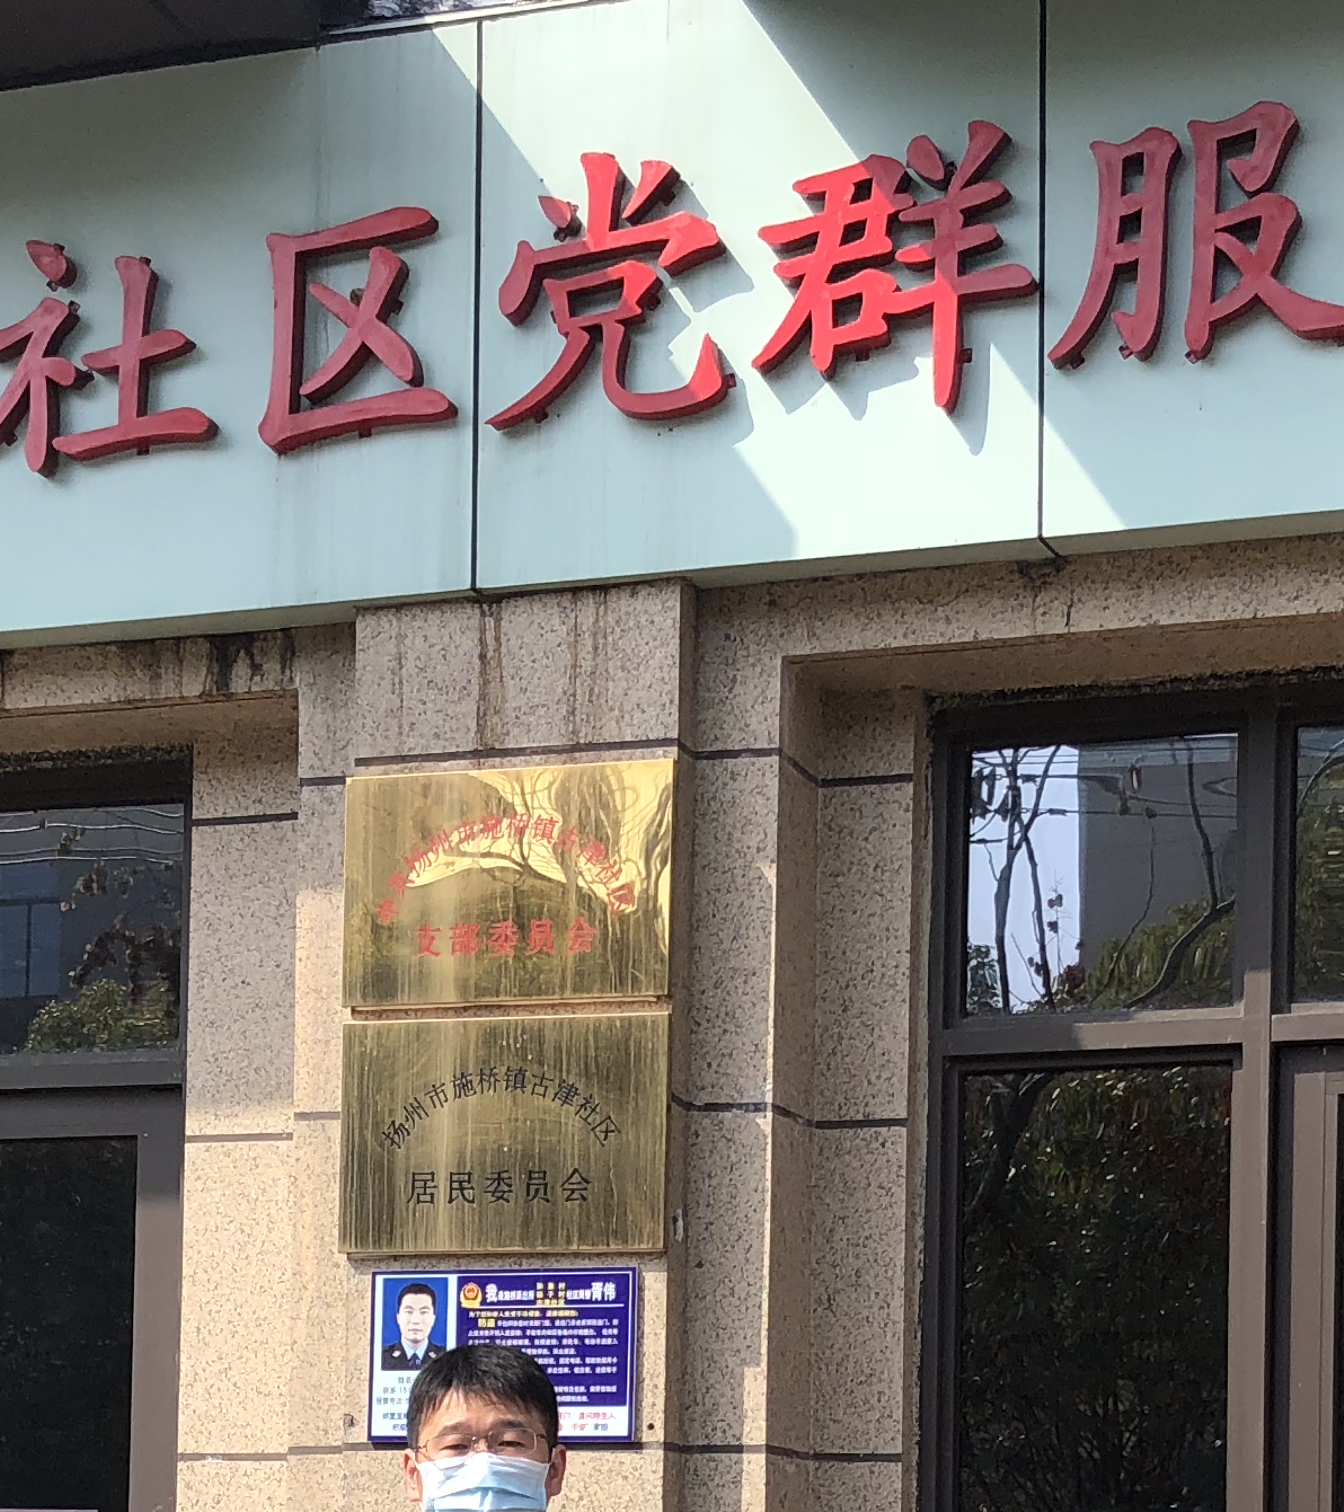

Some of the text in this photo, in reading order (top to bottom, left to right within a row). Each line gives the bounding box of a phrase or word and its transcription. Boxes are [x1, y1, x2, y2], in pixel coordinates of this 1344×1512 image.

[415, 916, 597, 959] 支部委员会
[382, 1066, 621, 1150] 扬州市施桥镇古津社区
[406, 1167, 593, 1204] 居民委员会
